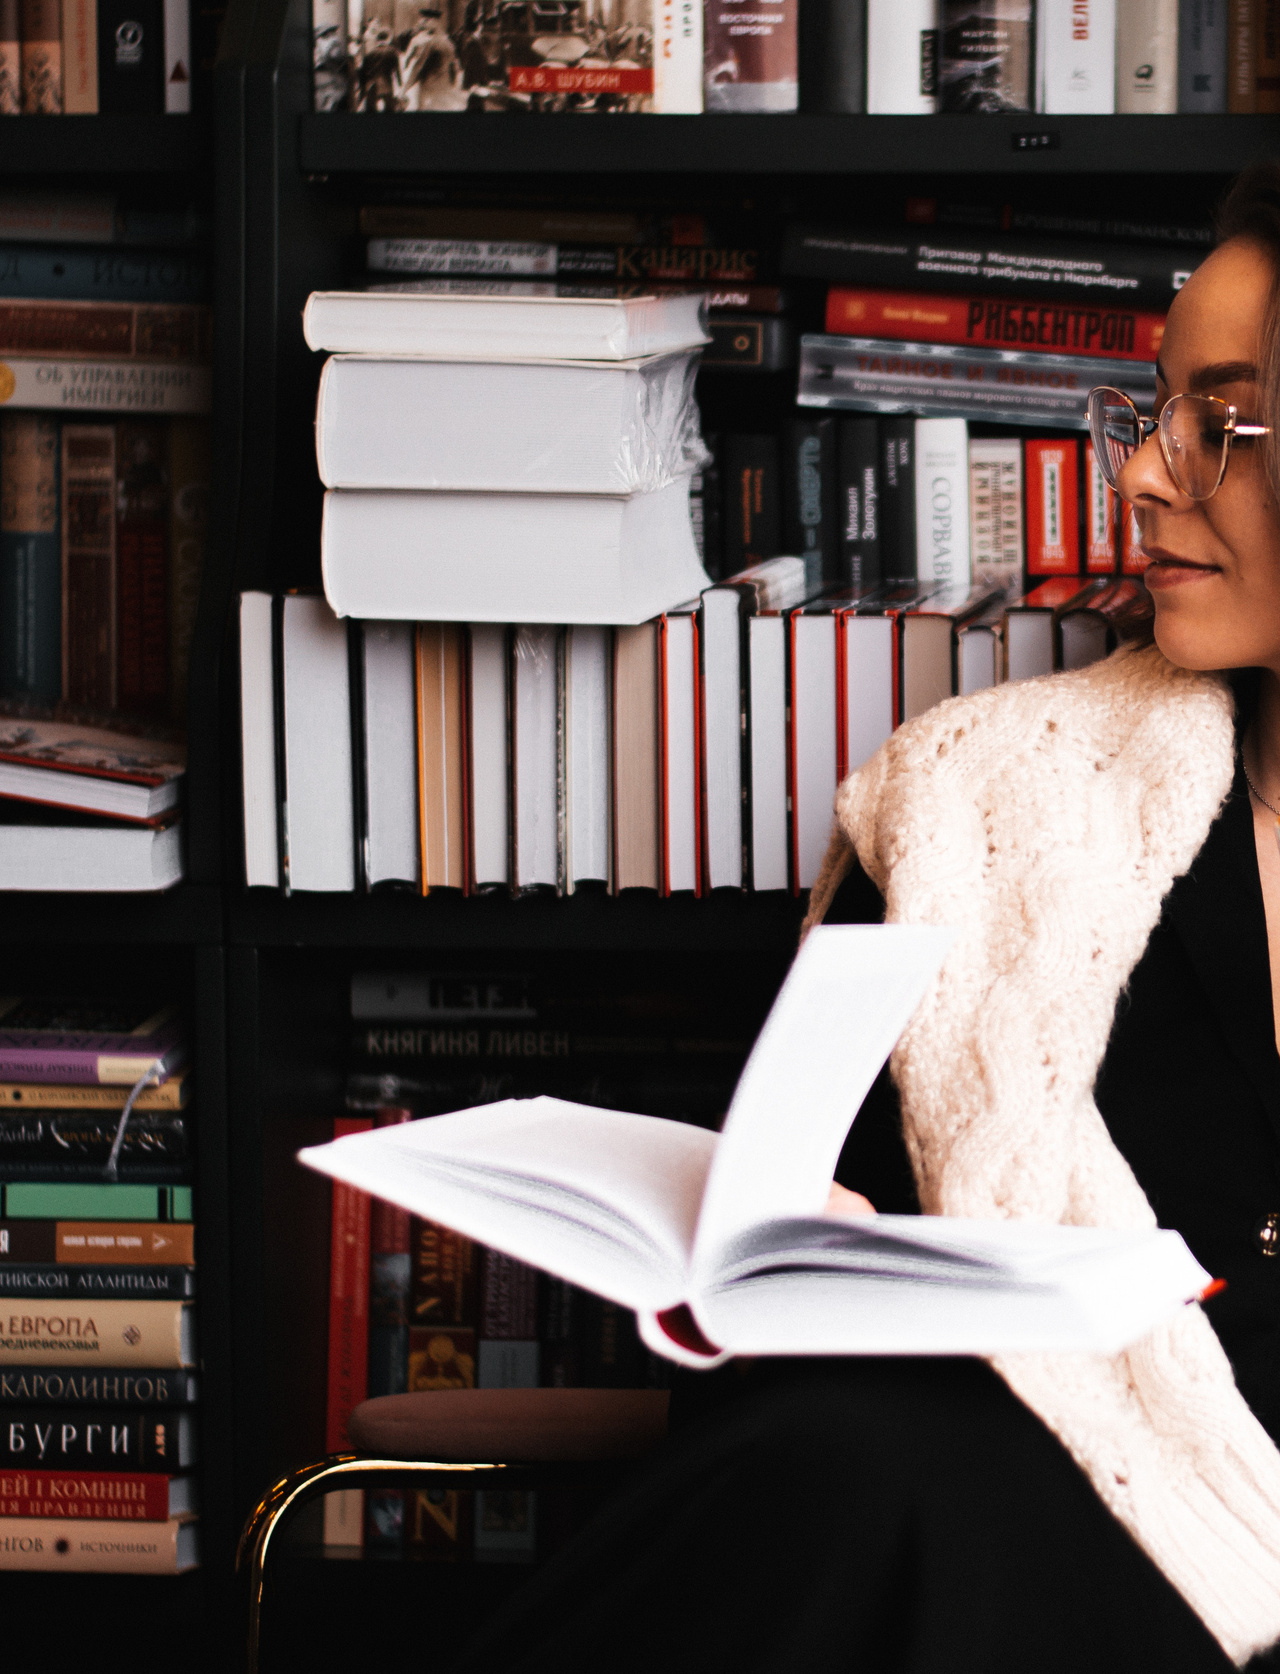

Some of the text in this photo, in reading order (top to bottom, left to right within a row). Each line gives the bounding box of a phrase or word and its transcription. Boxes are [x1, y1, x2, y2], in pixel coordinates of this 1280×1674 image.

[728, 25, 774, 36] ЕВРОПА
[556, 74, 621, 89] ШУБИН
[616, 245, 758, 281] Канарис
[918, 246, 1105, 273] Приговор Международного
[916, 260, 979, 276] военного
[981, 265, 1051, 283] трибунала
[1063, 271, 1140, 290] Нюрнберге
[965, 300, 1137, 353] РИББЕНТРОП
[857, 355, 955, 380] ТАЙНОЕ
[997, 369, 1080, 390] ЯВНОЕ
[845, 485, 859, 540] Михаил
[861, 466, 879, 540] Золотухин
[366, 1029, 570, 1057] КНЯГИНЯ ЛИВЕН
[8, 1316, 99, 1338] ЕВРОПА
[0, 1374, 169, 1402] КАРОЛИНГОВ
[8, 1423, 130, 1460] БУРГИ
[50, 1480, 147, 1500] КОМНИН
